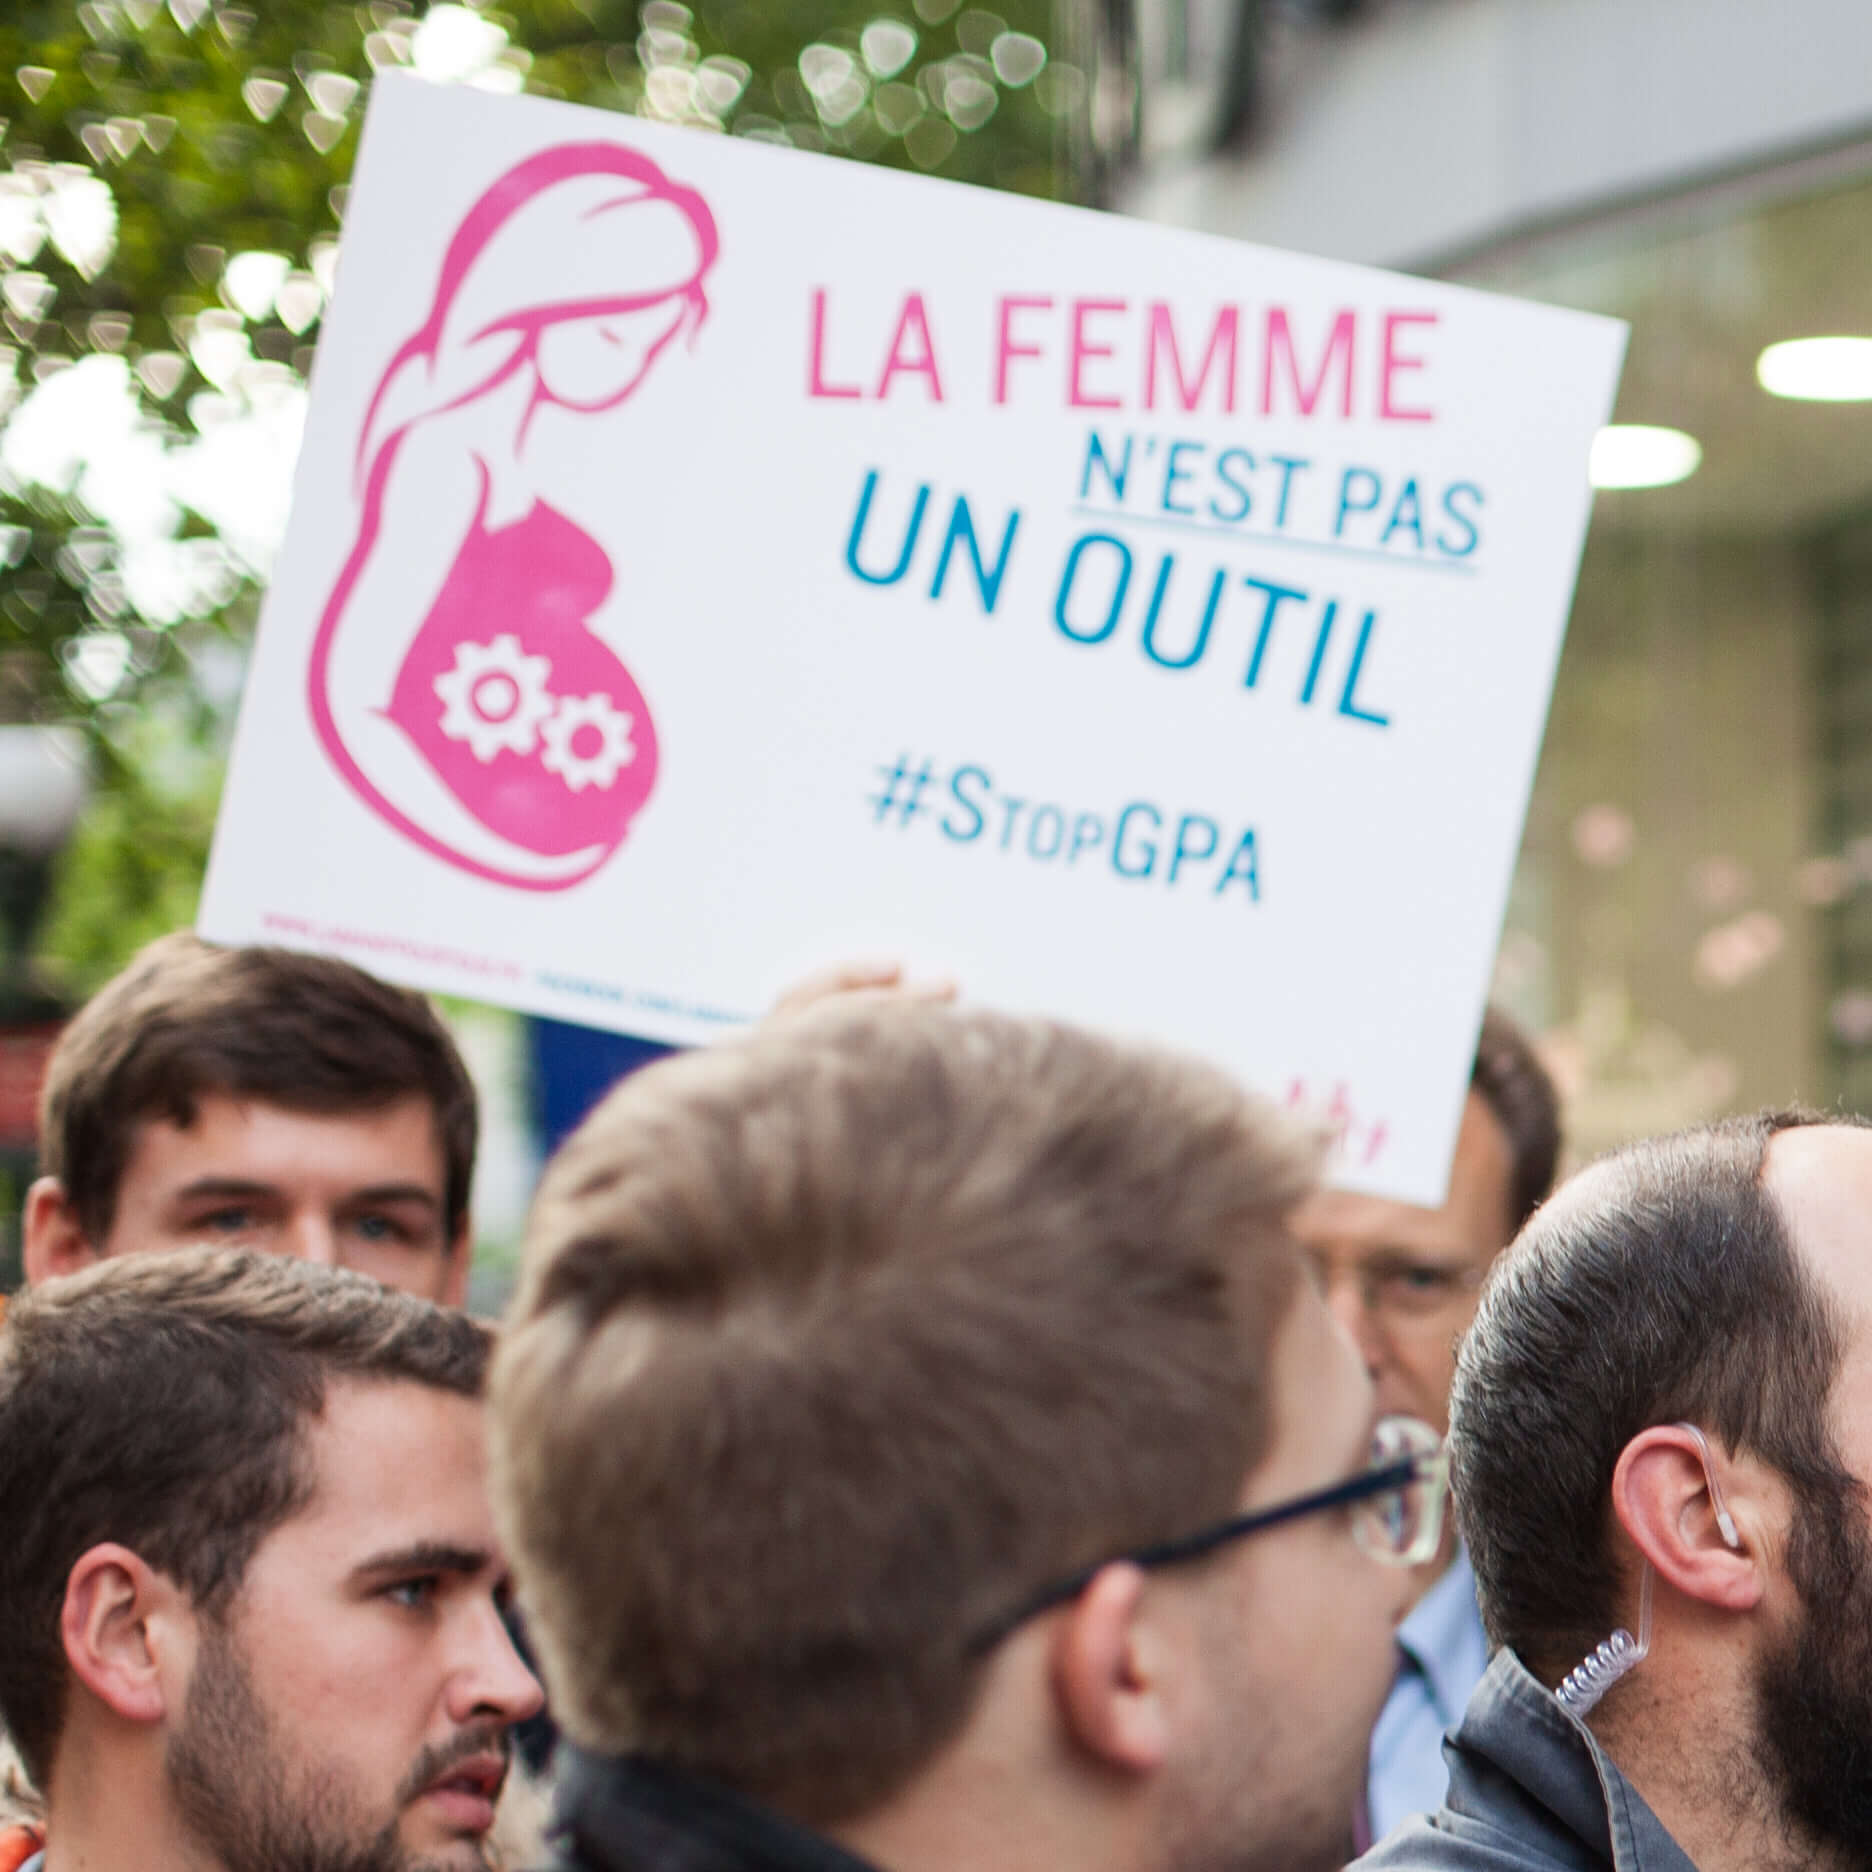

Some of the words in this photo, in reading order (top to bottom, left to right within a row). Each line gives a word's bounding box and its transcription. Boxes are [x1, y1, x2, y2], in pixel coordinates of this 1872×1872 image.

[806, 286, 948, 405] LA
[992, 294, 1440, 424] FEMME
[1077, 426, 1313, 532] N'EST
[1331, 464, 1486, 561] PAS
[841, 465, 1025, 619] UN
[1048, 527, 1394, 731] OUTIL
